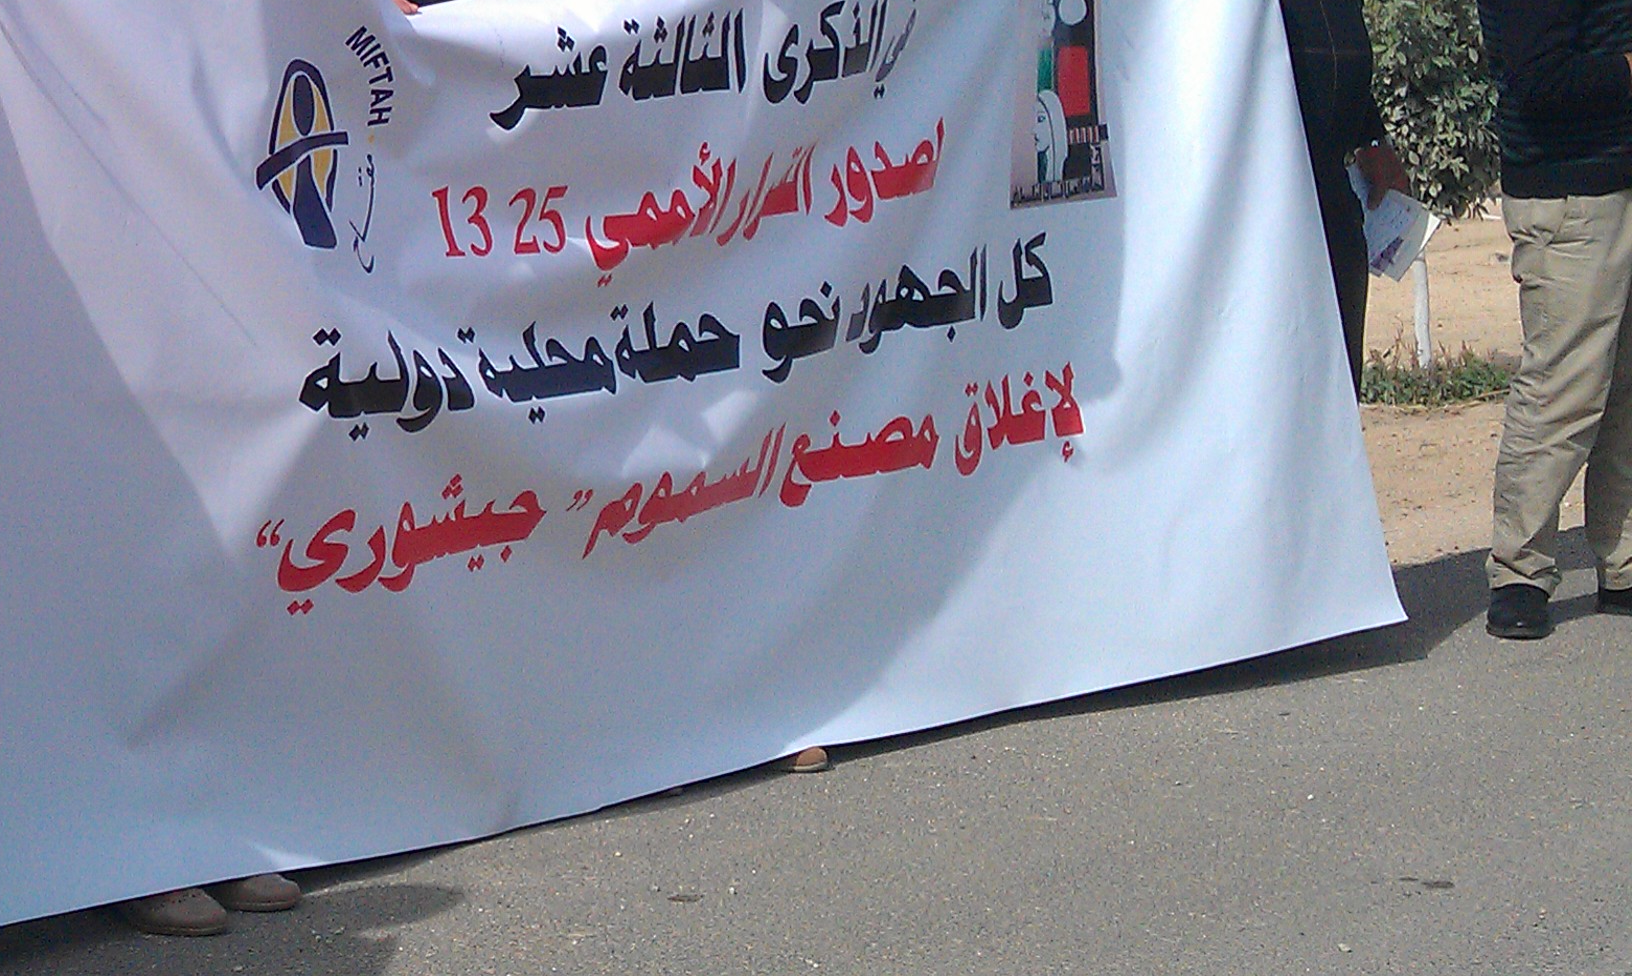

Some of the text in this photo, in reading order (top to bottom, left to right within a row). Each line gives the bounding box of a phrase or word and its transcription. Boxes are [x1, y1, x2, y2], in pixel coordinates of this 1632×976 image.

[345, 25, 394, 126] MIFTAH
[489, 26, 608, 131] عشر
[620, 8, 747, 101] الثالثة
[584, 141, 737, 288] الأممي
[715, 138, 818, 247] القرار
[823, 116, 945, 228] لصدور
[298, 231, 1054, 442] كل الجهود نحو حملة محلية دولية
[779, 410, 940, 508] مصنع
[954, 361, 1085, 477] لإغلاق
[581, 422, 787, 561] السموم
